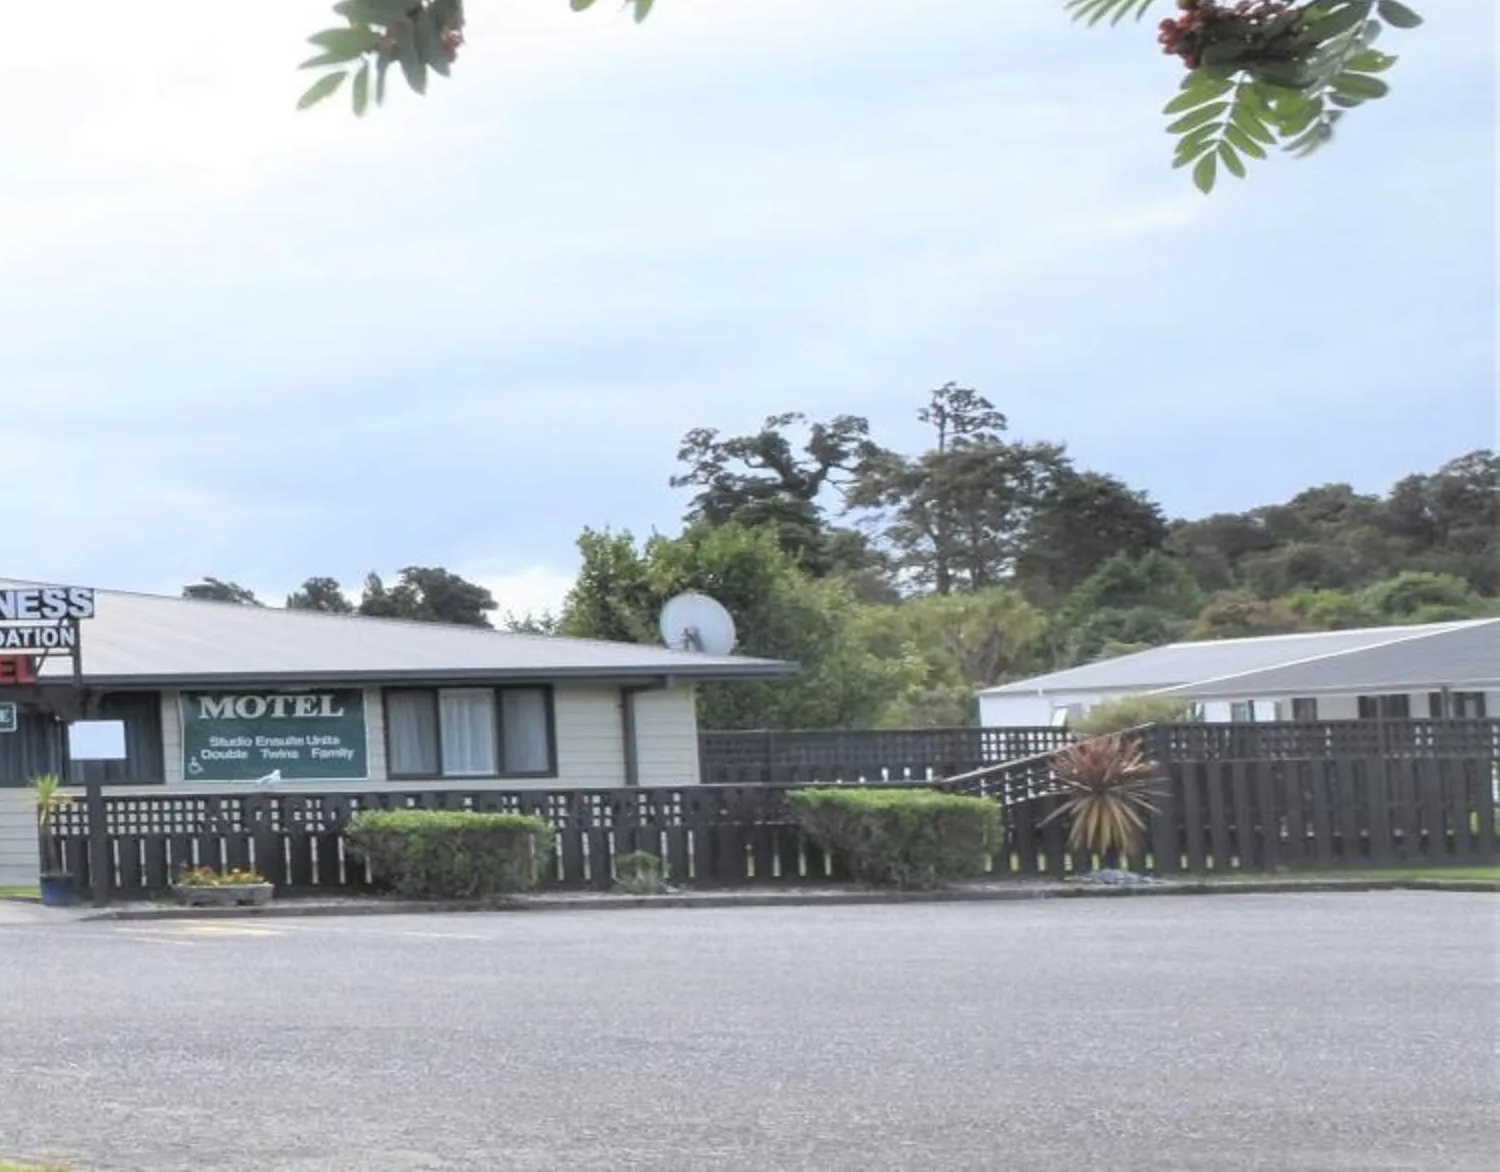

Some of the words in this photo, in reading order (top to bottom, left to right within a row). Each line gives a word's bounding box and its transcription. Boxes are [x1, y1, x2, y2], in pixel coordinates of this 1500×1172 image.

[197, 694, 345, 720] MOTEL
[208, 735, 253, 748] Studio
[305, 734, 341, 746] Units
[201, 748, 249, 760] Double
[260, 748, 300, 759] Twins
[311, 747, 355, 762] Family
